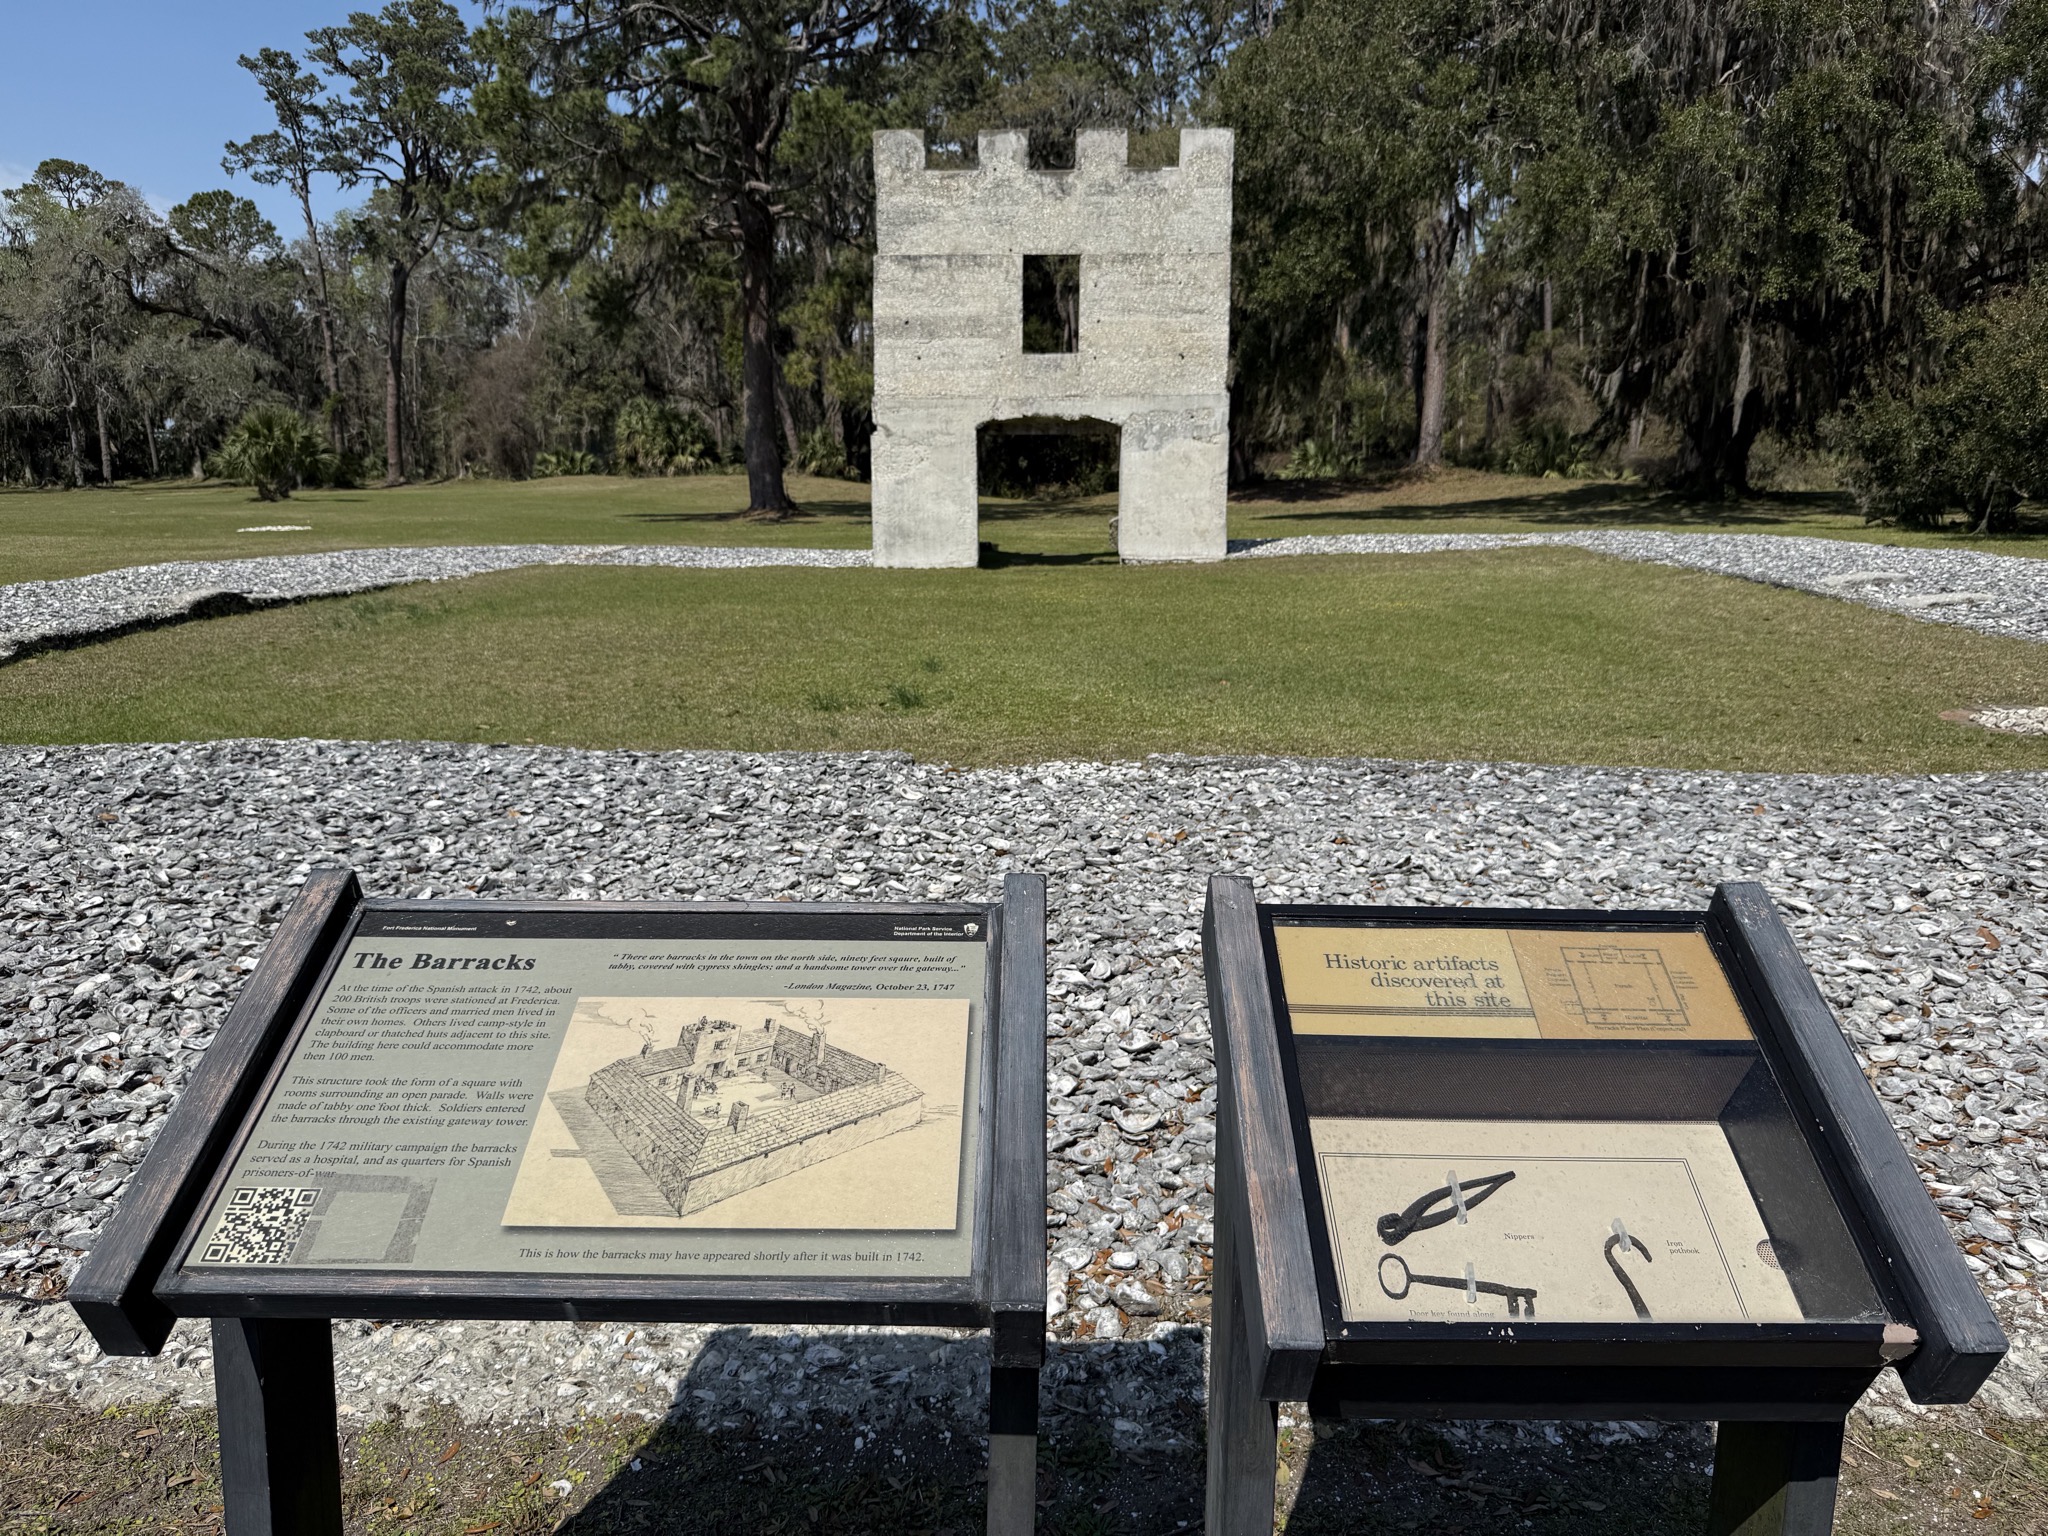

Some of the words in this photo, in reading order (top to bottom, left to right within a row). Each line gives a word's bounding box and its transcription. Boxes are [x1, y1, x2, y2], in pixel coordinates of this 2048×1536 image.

[352, 952, 403, 969] The
[408, 952, 536, 971] Barracks
[719, 953, 735, 961] the
[816, 954, 837, 962] side,
[839, 954, 868, 963] ninety
[867, 954, 887, 963] feet
[945, 955, 957, 964] of
[1323, 953, 1408, 969] Historic
[1413, 955, 1499, 971] artifacts
[607, 962, 635, 971] tabby,
[637, 962, 675, 970] covered
[675, 962, 695, 970] with
[731, 963, 773, 971] shingles;
[825, 982, 872, 991] Magazine,
[915, 983, 929, 991] 23,
[932, 983, 955, 991] 1747
[1371, 972, 1477, 989] discovered
[1485, 975, 1505, 988] at
[352, 983, 369, 992] the
[370, 984, 394, 992] time
[395, 985, 409, 993] of
[410, 985, 424, 993] the
[426, 984, 466, 995] Spanish
[467, 985, 498, 993] attack
[500, 985, 511, 993] in
[514, 985, 541, 994] 1742,
[543, 985, 573, 994] about
[332, 994, 353, 1003] 200
[354, 995, 387, 1003] British
[389, 996, 421, 1005] troops
[449, 995, 497, 1004] stationed
[510, 996, 560, 1005] Frederica.
[1425, 991, 1467, 1007] this
[1474, 993, 1511, 1007] site
[320, 1016, 345, 1025] their
[370, 1017, 406, 1026] homes.
[412, 1017, 447, 1026] Others
[448, 1018, 476, 1027] lived
[476, 1018, 533, 1029] camp-style
[535, 1018, 546, 1027] in
[314, 1028, 366, 1039] clapboard
[380, 1029, 425, 1038] thatched
[425, 1029, 448, 1038] huts
[449, 1029, 494, 1040] adjacent
[495, 1031, 506, 1039] to
[508, 1030, 528, 1039] this
[529, 1030, 551, 1039] site.
[308, 1039, 330, 1048] The
[331, 1039, 375, 1051] building
[376, 1040, 400, 1049] here
[401, 1041, 432, 1050] could
[431, 1041, 504, 1050] accommodate
[302, 1051, 326, 1060] then
[328, 1051, 349, 1060] 100
[291, 1075, 315, 1085] This
[315, 1077, 363, 1086] structure
[364, 1076, 389, 1086] took
[390, 1077, 408, 1086] the
[409, 1077, 436, 1086] form
[437, 1077, 453, 1086] of
[460, 1080, 496, 1089] square
[499, 1078, 523, 1087] with
[318, 1088, 384, 1100] surrounding
[401, 1091, 428, 1101] open
[428, 1090, 467, 1101] parade.
[476, 1090, 505, 1100] Walls
[270, 1112, 288, 1123] the
[289, 1113, 336, 1123] barracks
[338, 1114, 380, 1126] through
[382, 1114, 400, 1124] the
[402, 1115, 446, 1127] existing
[446, 1117, 493, 1128] gateway
[495, 1118, 528, 1126] tower.
[256, 1139, 297, 1152] During
[298, 1140, 316, 1150] the
[319, 1140, 347, 1150] 1742
[348, 1141, 393, 1153] military
[394, 1141, 448, 1154] campaign
[450, 1142, 468, 1152] the
[470, 1142, 518, 1153] barracks
[1504, 1233, 1535, 1241] Nippers
[519, 1248, 542, 1258] This
[545, 1249, 553, 1258] is
[556, 1249, 579, 1259] how
[582, 1249, 599, 1259] the
[601, 1250, 646, 1259] barracks
[649, 1252, 672, 1262] may
[675, 1250, 700, 1260] have
[703, 1251, 750, 1263] appeared
[753, 1251, 789, 1263] shortly
[793, 1251, 818, 1261] after
[821, 1252, 830, 1261] it
[855, 1252, 879, 1262] built
[882, 1252, 892, 1262] in
[897, 1252, 925, 1262] 1742.
